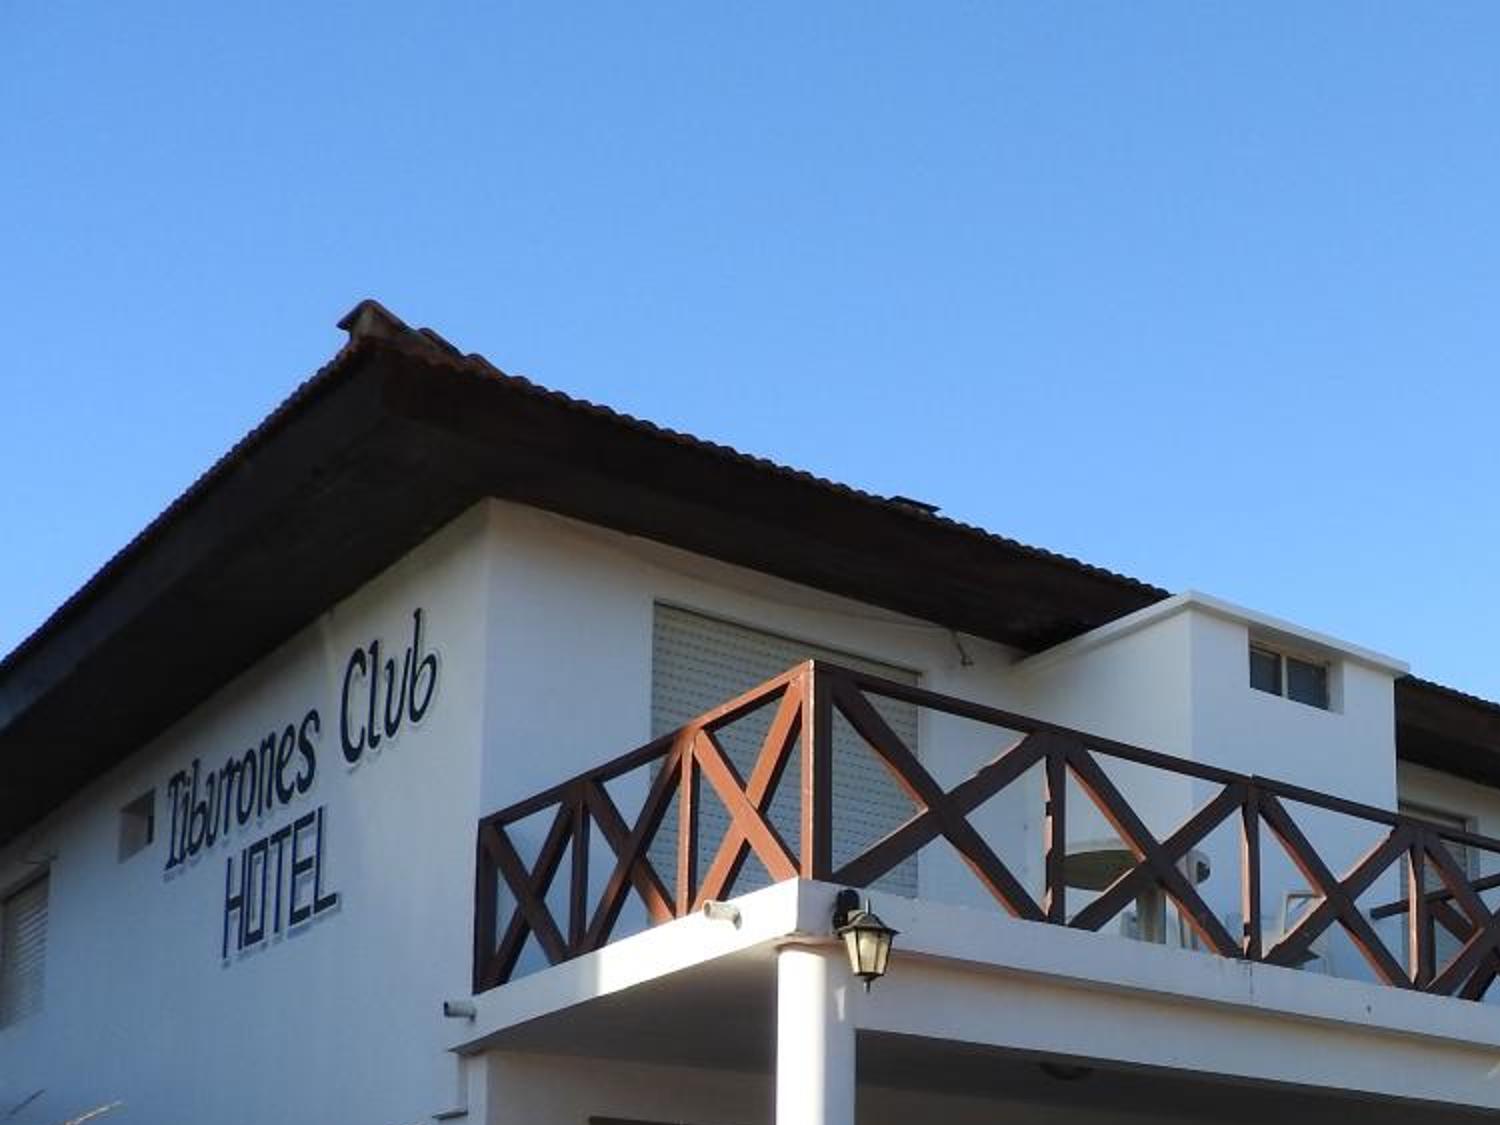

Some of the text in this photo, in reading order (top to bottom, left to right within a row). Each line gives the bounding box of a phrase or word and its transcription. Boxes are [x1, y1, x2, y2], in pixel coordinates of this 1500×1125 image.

[164, 607, 438, 871] Tiburones Club
[222, 805, 338, 959] HOTEL
